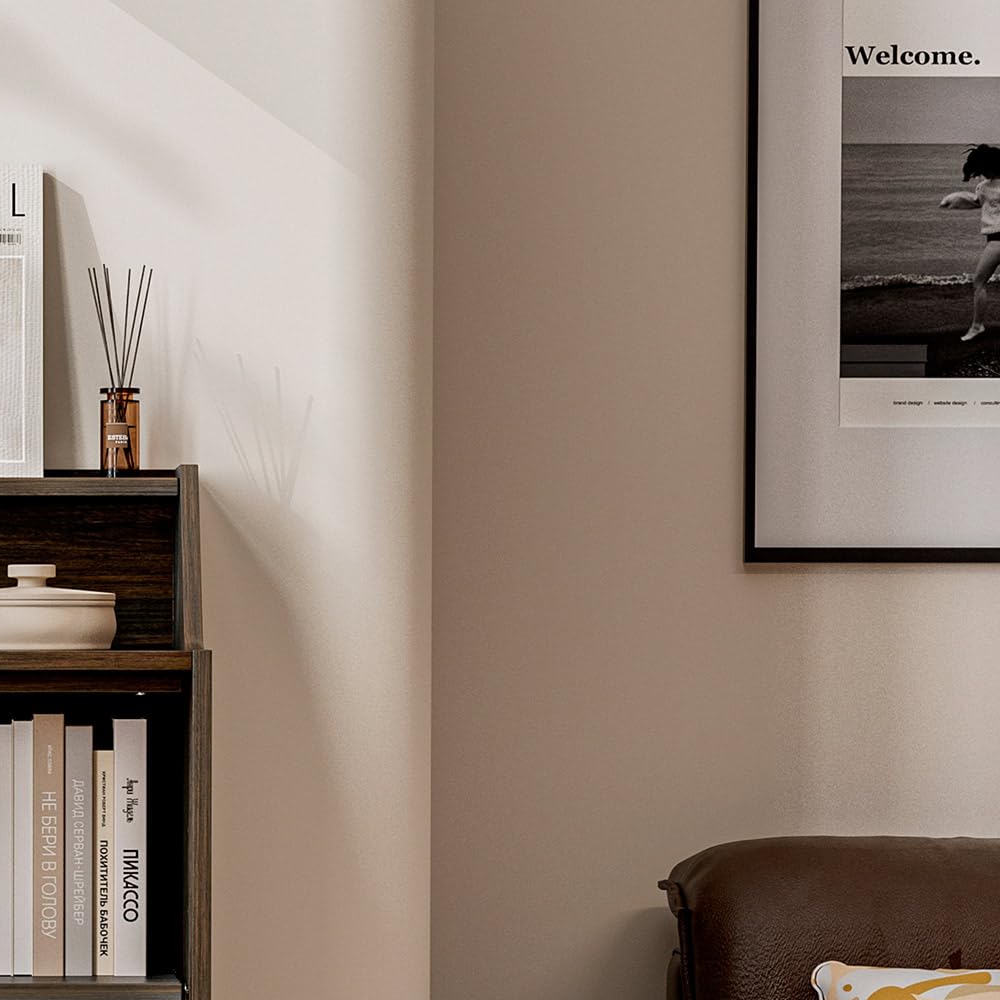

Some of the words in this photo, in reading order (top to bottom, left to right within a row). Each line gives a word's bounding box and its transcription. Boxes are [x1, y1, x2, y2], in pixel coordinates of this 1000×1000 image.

[844, 44, 981, 66] Welcome.
[41, 791, 57, 810] НЕ
[72, 779, 85, 817] ДАВИД
[41, 815, 57, 856] БЕРИ
[41, 862, 57, 872] В
[73, 820, 85, 926] СЕРВАН-ШРЕЙБЕР
[100, 840, 109, 907] ПОХИТИТЕЛЬ
[123, 849, 139, 923] ПИКАССО
[41, 875, 57, 939] ГОЛОВУ
[100, 909, 109, 957] БАБОЧЕК
